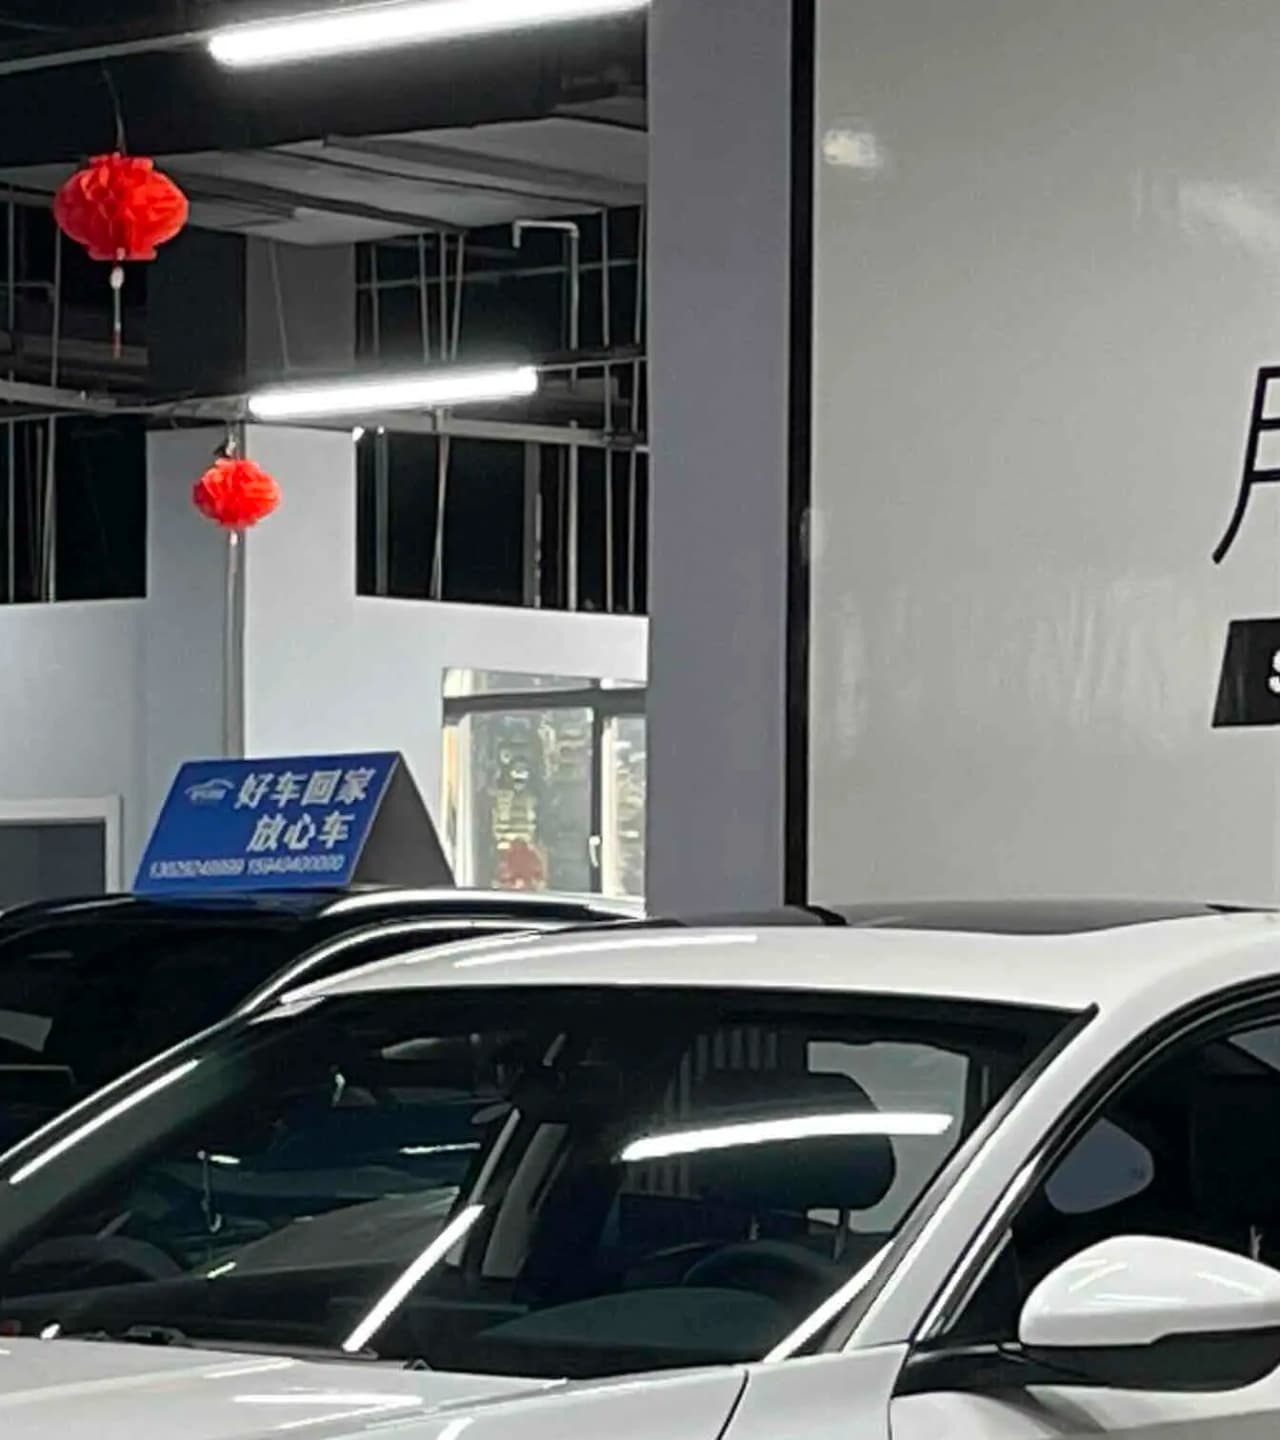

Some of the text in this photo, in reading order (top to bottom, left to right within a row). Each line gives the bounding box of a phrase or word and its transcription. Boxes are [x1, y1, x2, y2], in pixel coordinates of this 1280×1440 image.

[233, 766, 376, 810] 好车回家
[246, 810, 356, 852] 放心车
